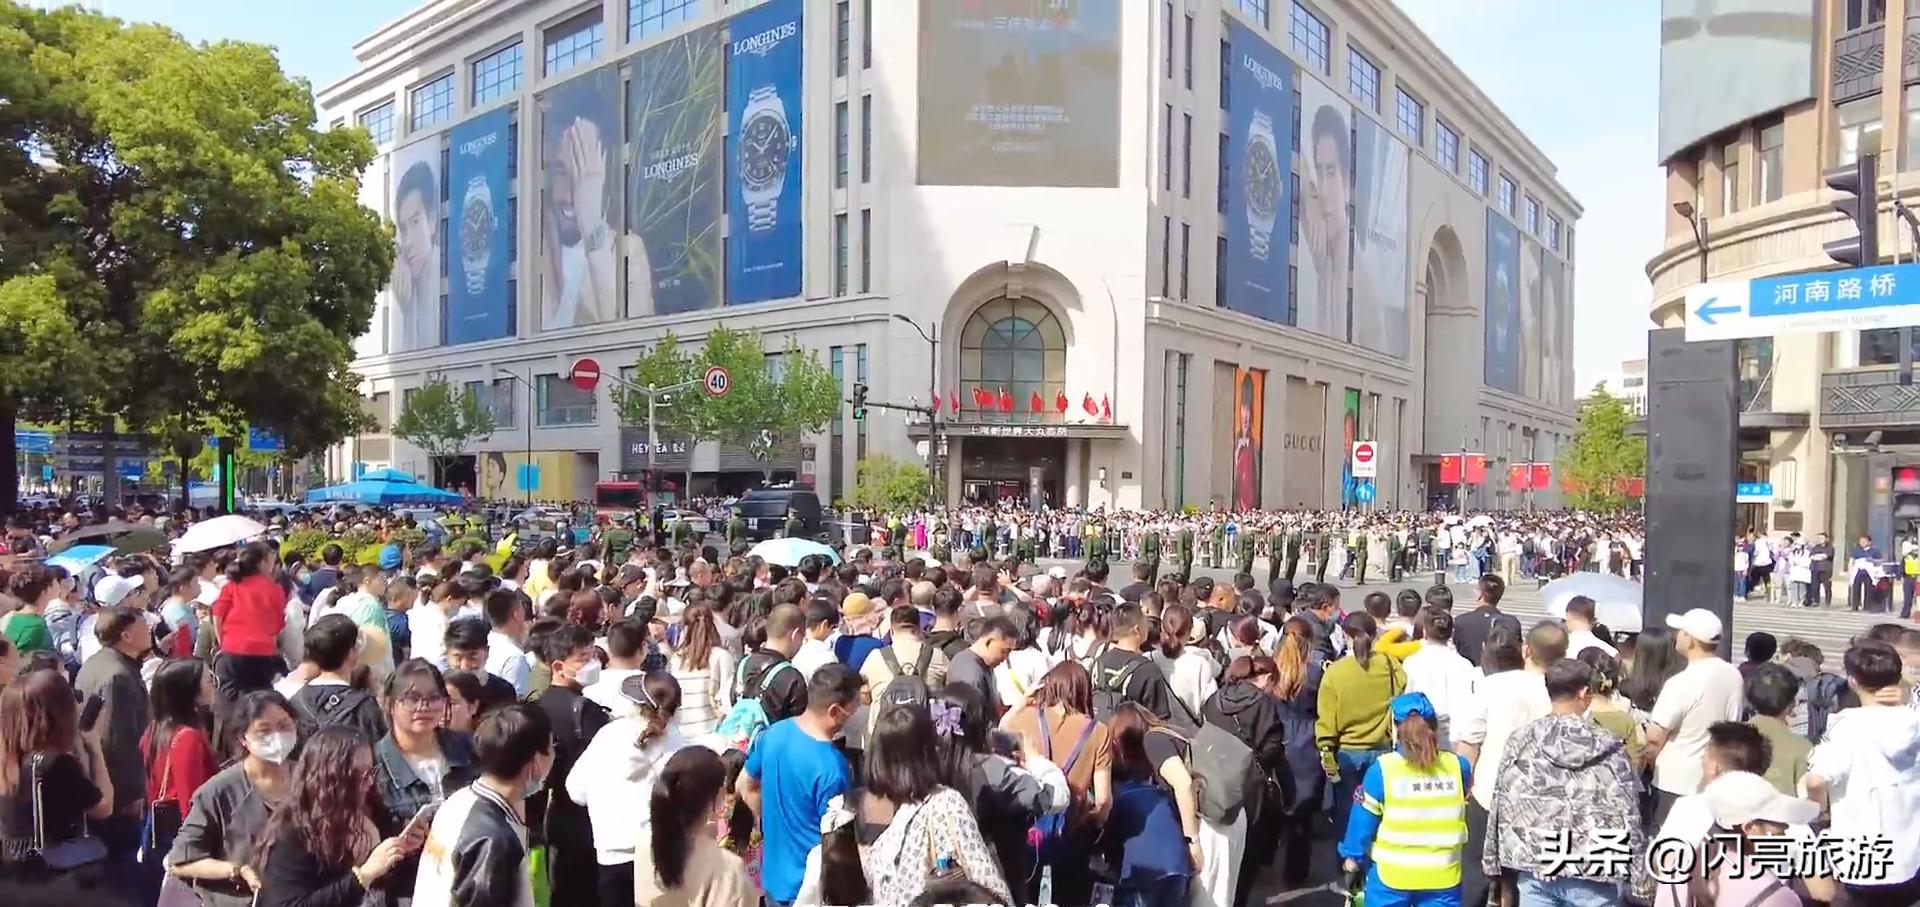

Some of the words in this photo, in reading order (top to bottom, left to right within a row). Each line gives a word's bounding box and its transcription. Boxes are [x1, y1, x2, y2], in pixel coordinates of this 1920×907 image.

[733, 21, 796, 56] LONGINES
[644, 153, 698, 179] LONGINES
[1774, 273, 1896, 305] 河南路桥
[711, 374, 725, 389] 40
[632, 443, 668, 454] HEYEA
[1283, 433, 1320, 452] GUCCI
